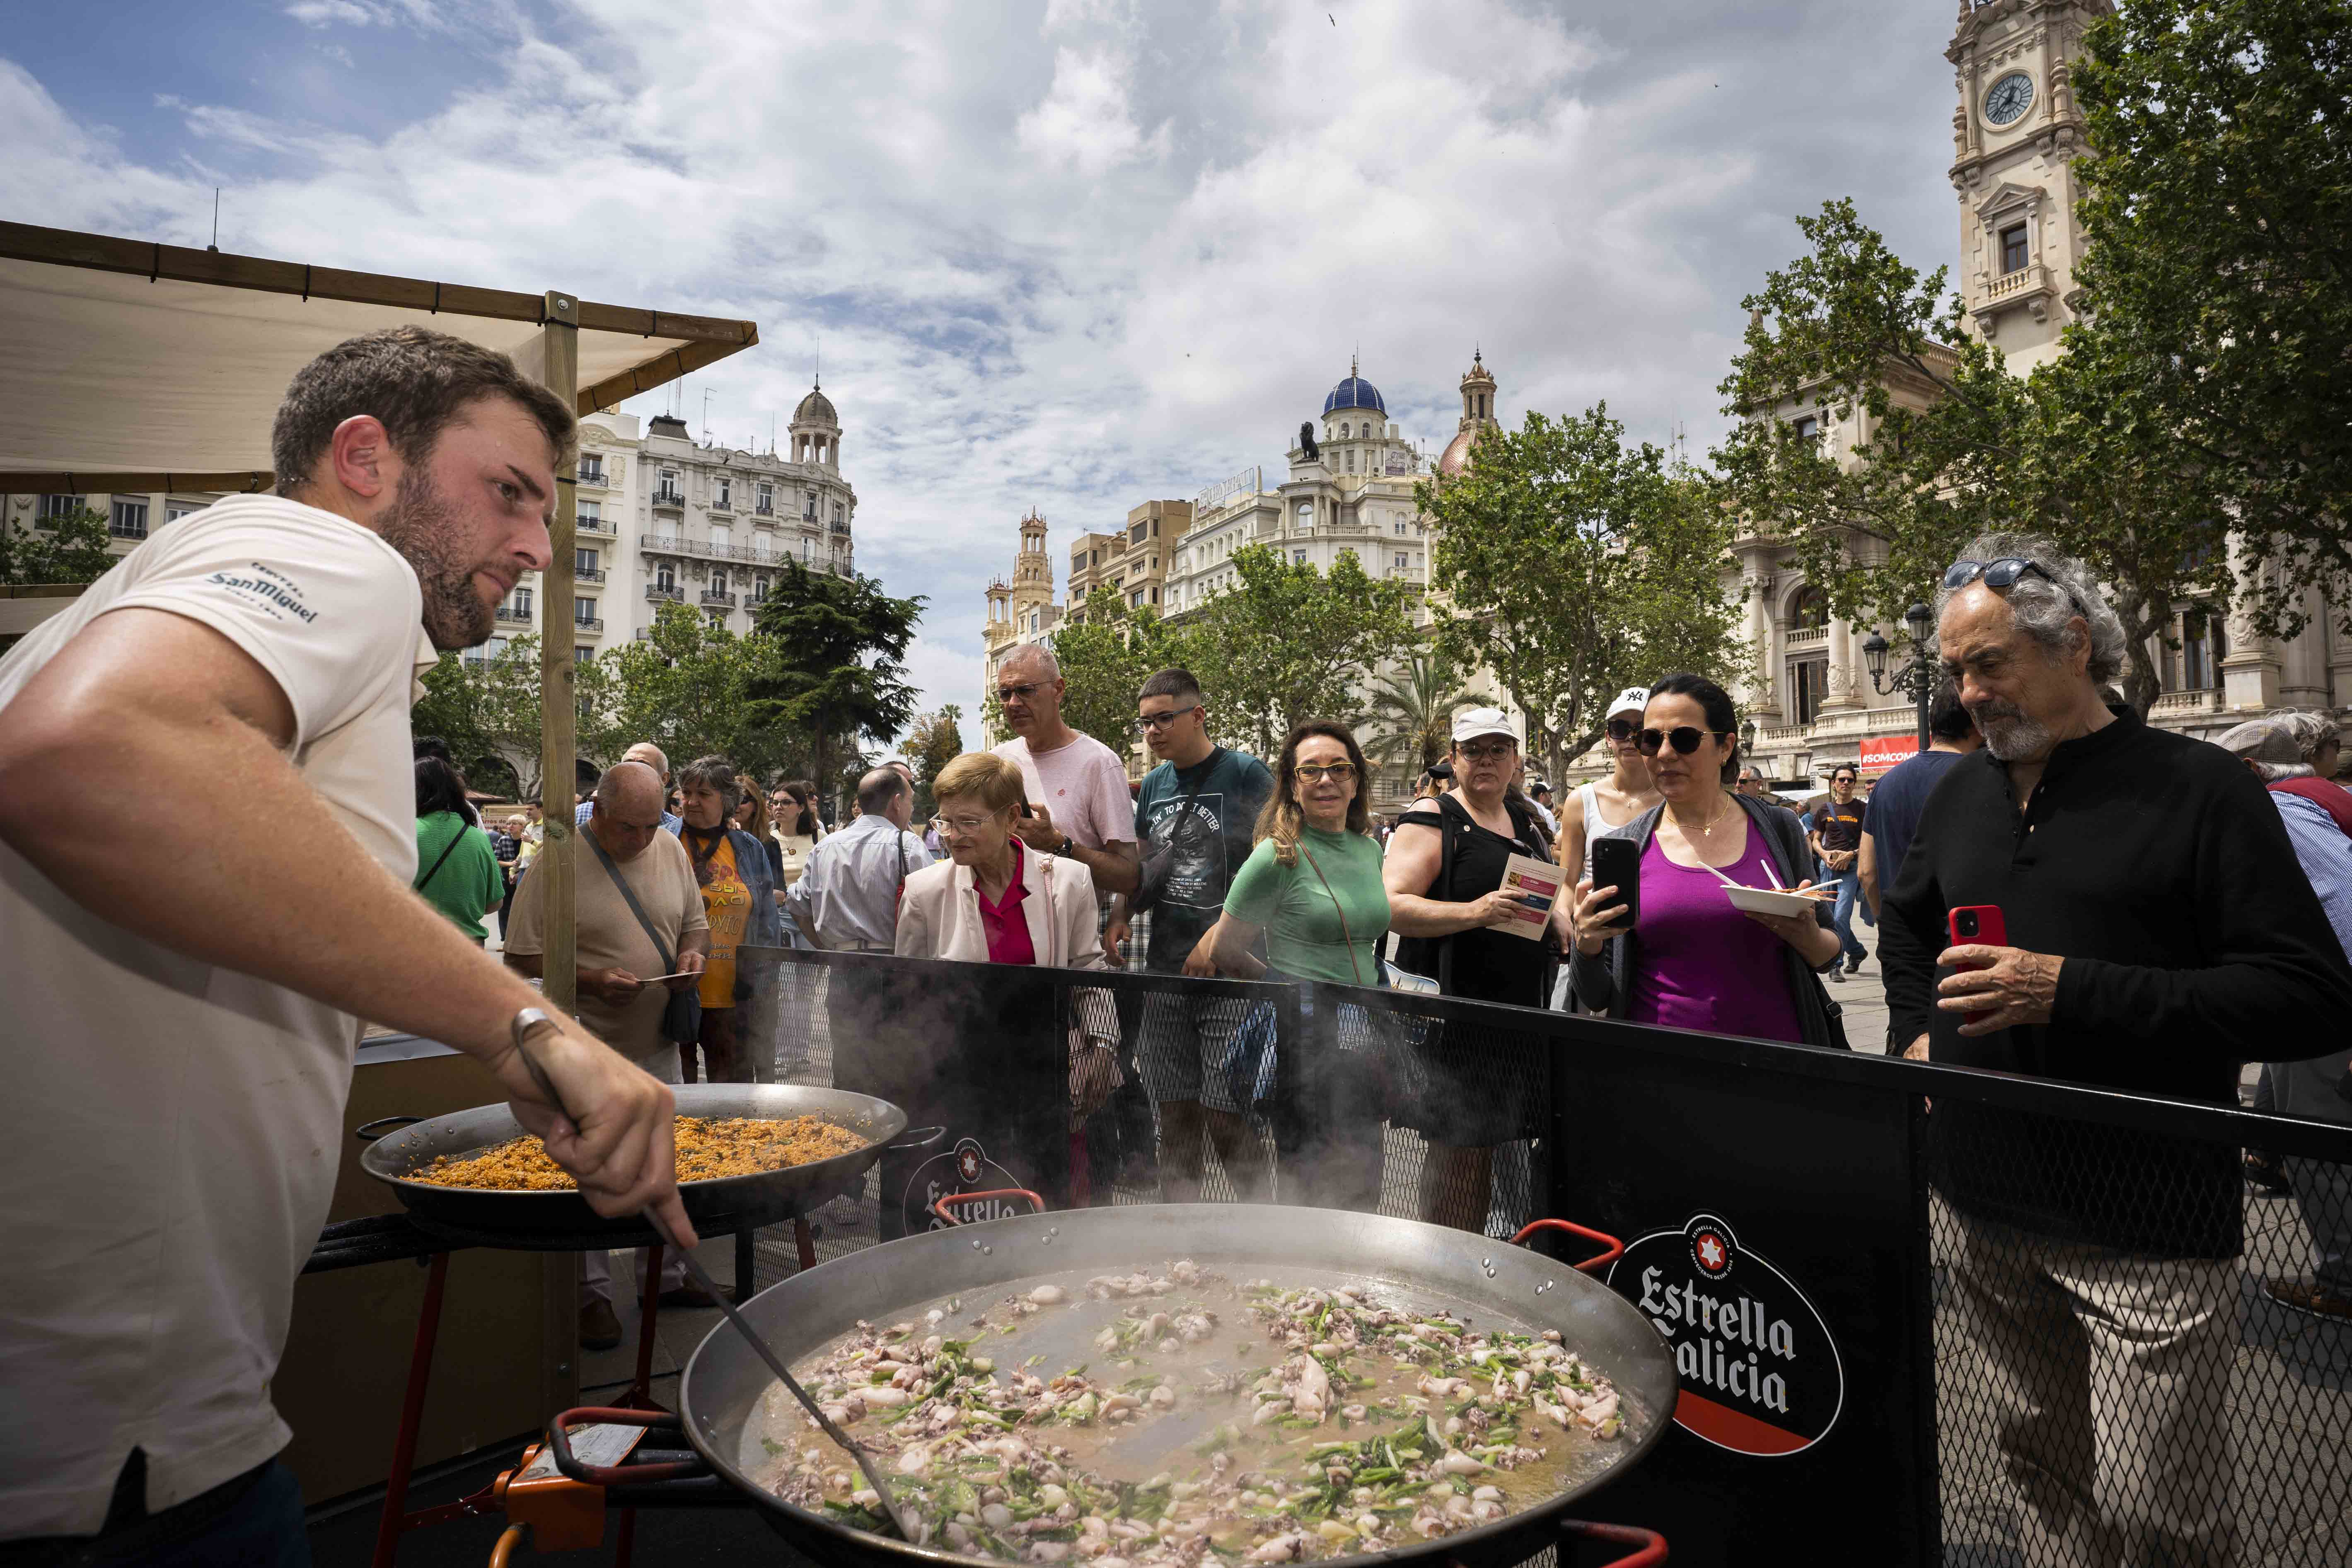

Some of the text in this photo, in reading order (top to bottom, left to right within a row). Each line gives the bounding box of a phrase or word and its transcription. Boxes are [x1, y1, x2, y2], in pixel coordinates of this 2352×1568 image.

[1627, 691, 1643, 701] NY
[1165, 805, 1174, 816] TO
[1197, 806, 1220, 833] BETTER
[1692, 1225, 1730, 1248] ESTRELLA GALICIA
[1690, 1249, 1713, 1279] CERVECEROS
[1714, 1271, 1728, 1280] DESDE
[1639, 1265, 1796, 1360] Estrella
